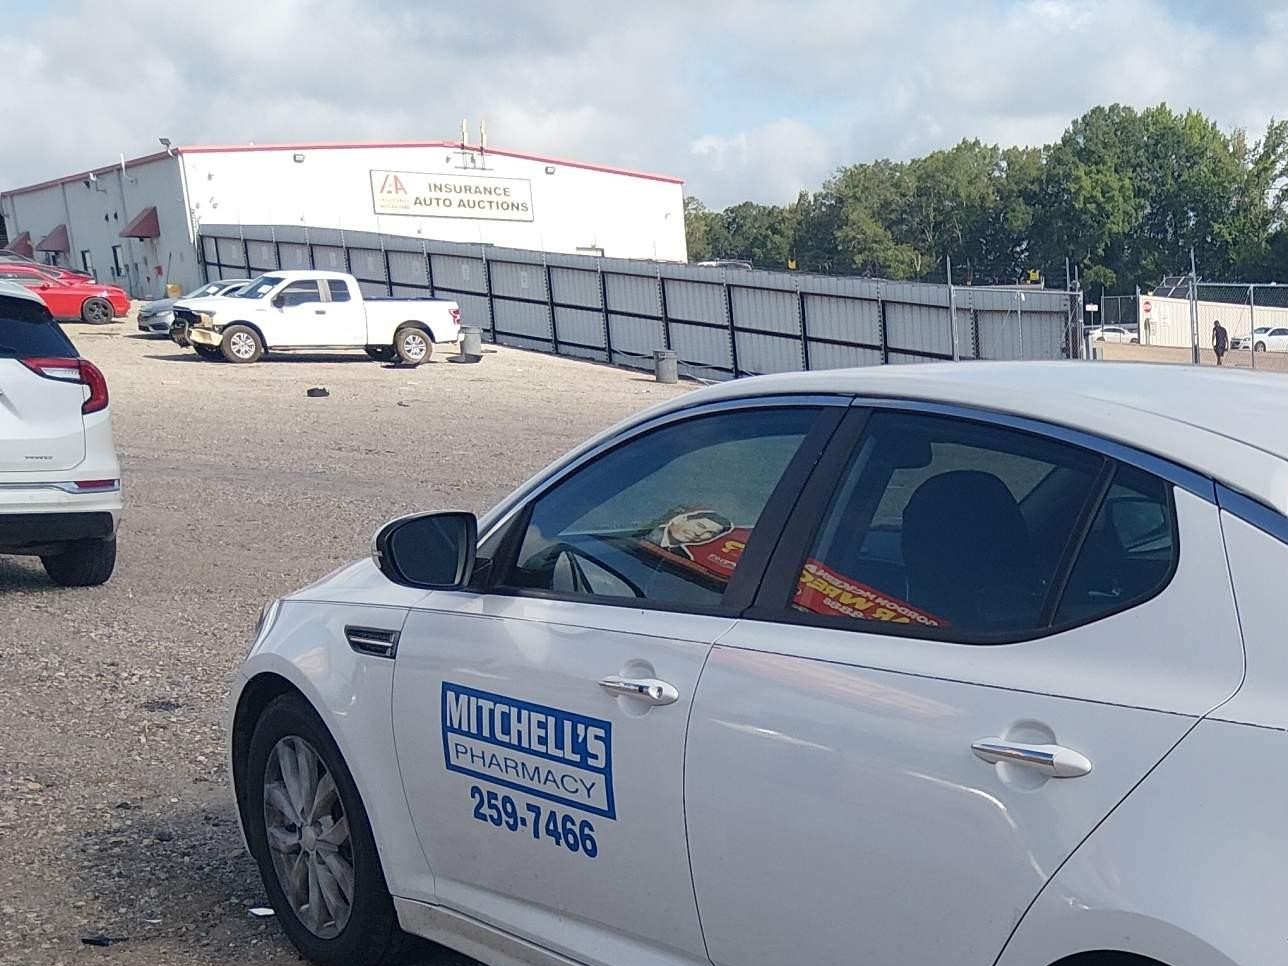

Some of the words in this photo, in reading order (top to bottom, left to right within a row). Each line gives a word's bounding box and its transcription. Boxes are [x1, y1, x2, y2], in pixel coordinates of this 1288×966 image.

[413, 196, 452, 208] AUTO
[457, 199, 529, 212] AUCTIONS
[428, 182, 512, 197] INSURANCE
[446, 690, 606, 769] MITCHELL'S
[454, 742, 596, 799] PHARMACY
[470, 785, 598, 858] 259-7466
